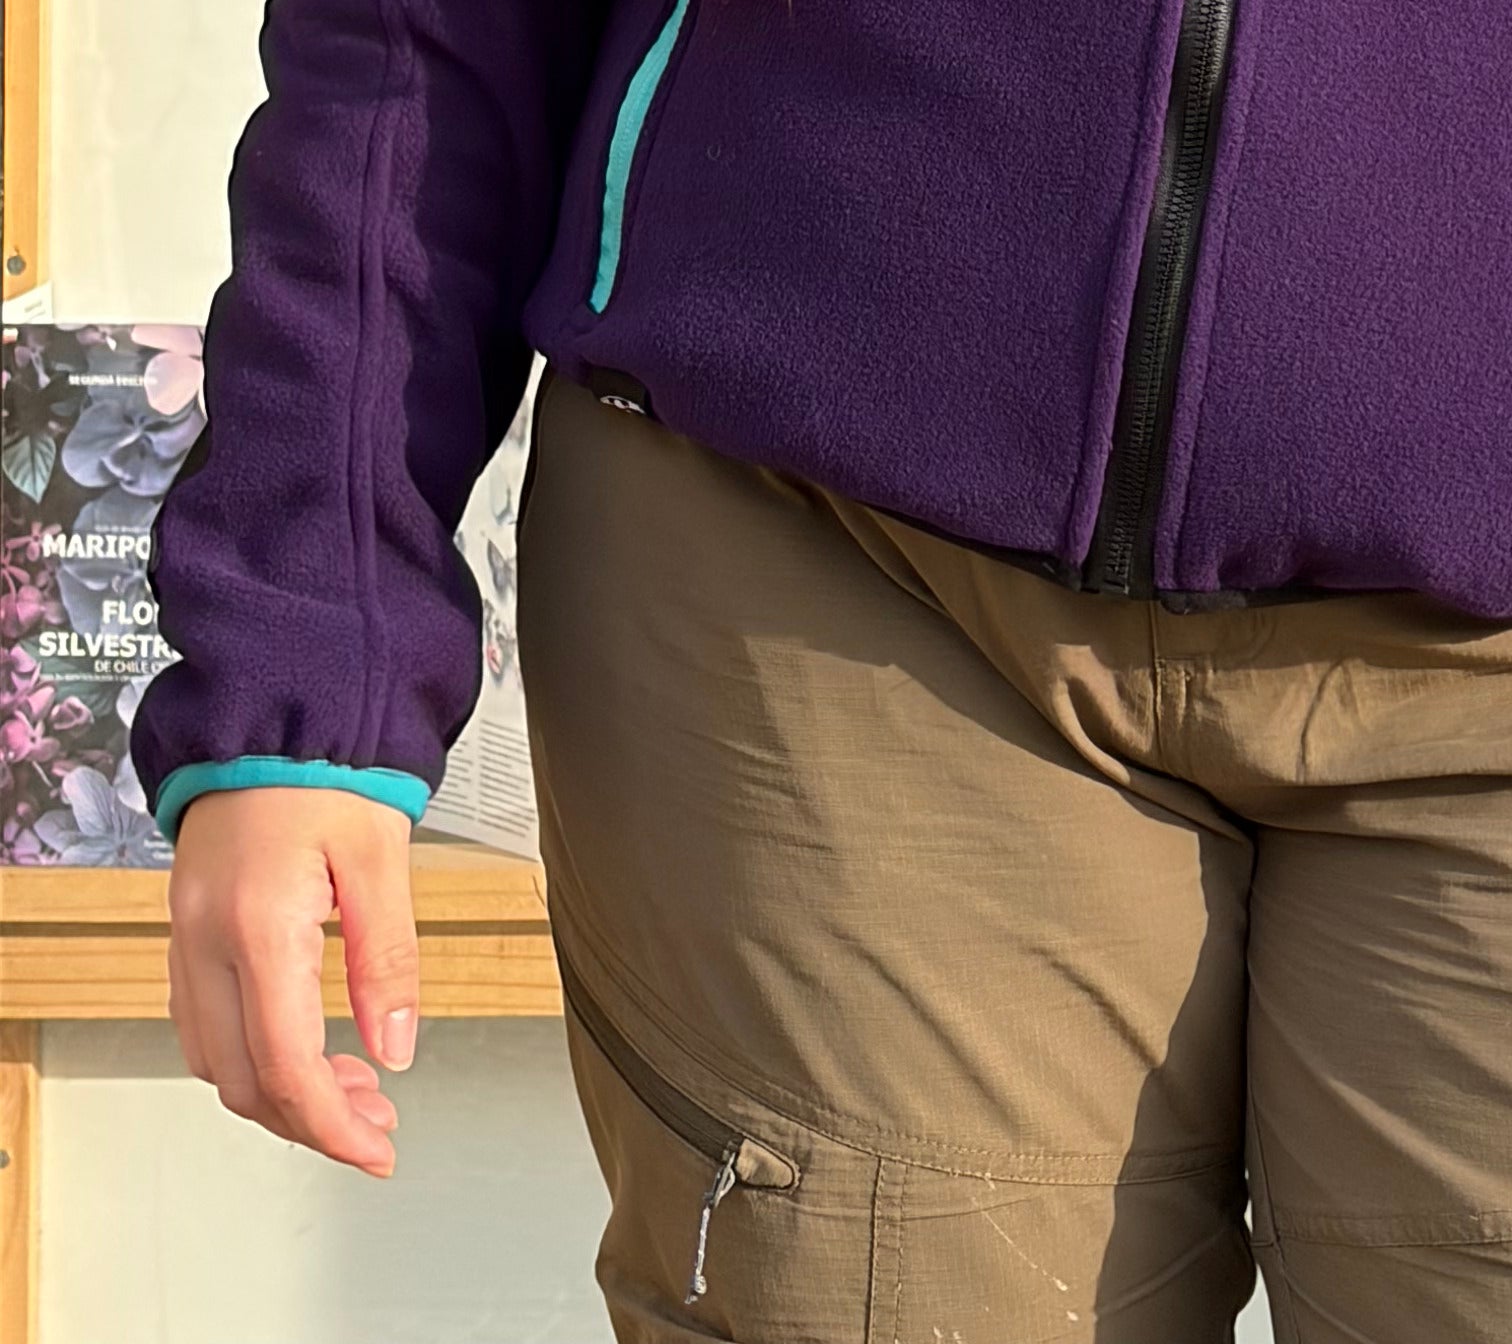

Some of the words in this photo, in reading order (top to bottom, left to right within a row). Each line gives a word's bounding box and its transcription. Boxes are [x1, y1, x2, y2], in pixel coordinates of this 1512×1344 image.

[39, 631, 183, 659] SILVESTR
[94, 659, 111, 673] DE
[113, 660, 149, 674] CHILE
